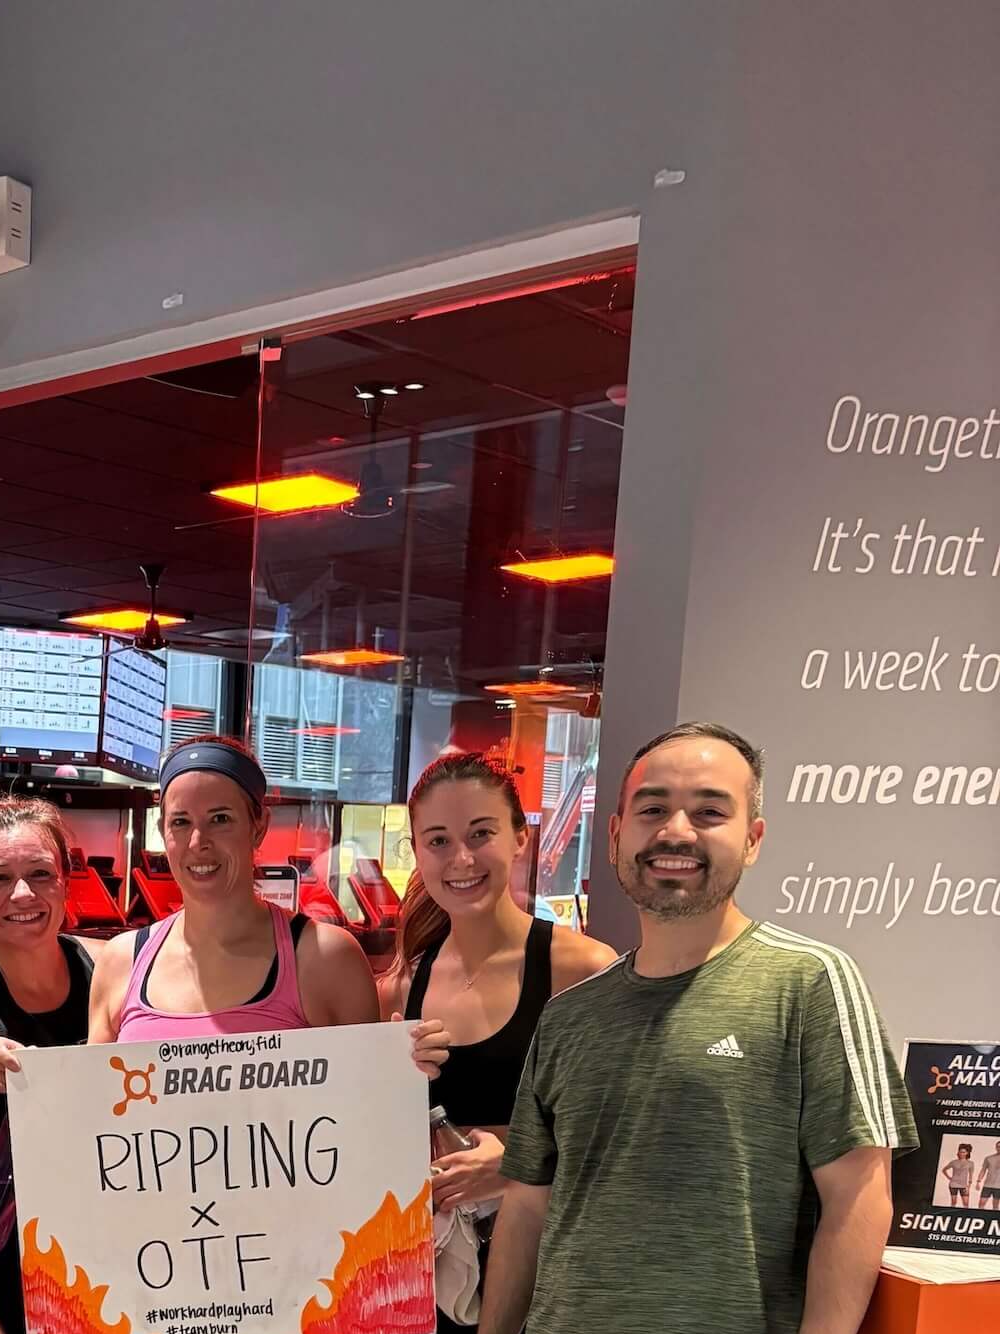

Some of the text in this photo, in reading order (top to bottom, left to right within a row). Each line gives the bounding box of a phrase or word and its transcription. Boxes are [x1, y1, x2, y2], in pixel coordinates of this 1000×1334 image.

[827, 395, 1000, 472] Oranget
[812, 517, 880, 574] It's
[892, 518, 984, 577] that
[801, 648, 828, 689] a
[843, 636, 949, 692] week
[786, 762, 903, 804] more
[776, 860, 915, 929] simply
[158, 1034, 282, 1062] @orangetheoryfidi
[706, 1047, 744, 1058] adidas
[947, 1054, 988, 1071] ALL
[163, 1058, 329, 1096] BRAG BOARD
[953, 1071, 1000, 1088] MAY
[940, 1099, 997, 1109] MIND-BENDING
[949, 1109, 981, 1119] CLASSES
[982, 1111, 993, 1119] TO
[935, 1119, 996, 1130] UNPREDICTABLE
[96, 1116, 339, 1193] RIPPLING
[899, 1212, 951, 1232] SIGN
[953, 1216, 985, 1235] UP
[940, 1234, 996, 1246] REGISTRATION
[137, 1232, 271, 1291] OTF
